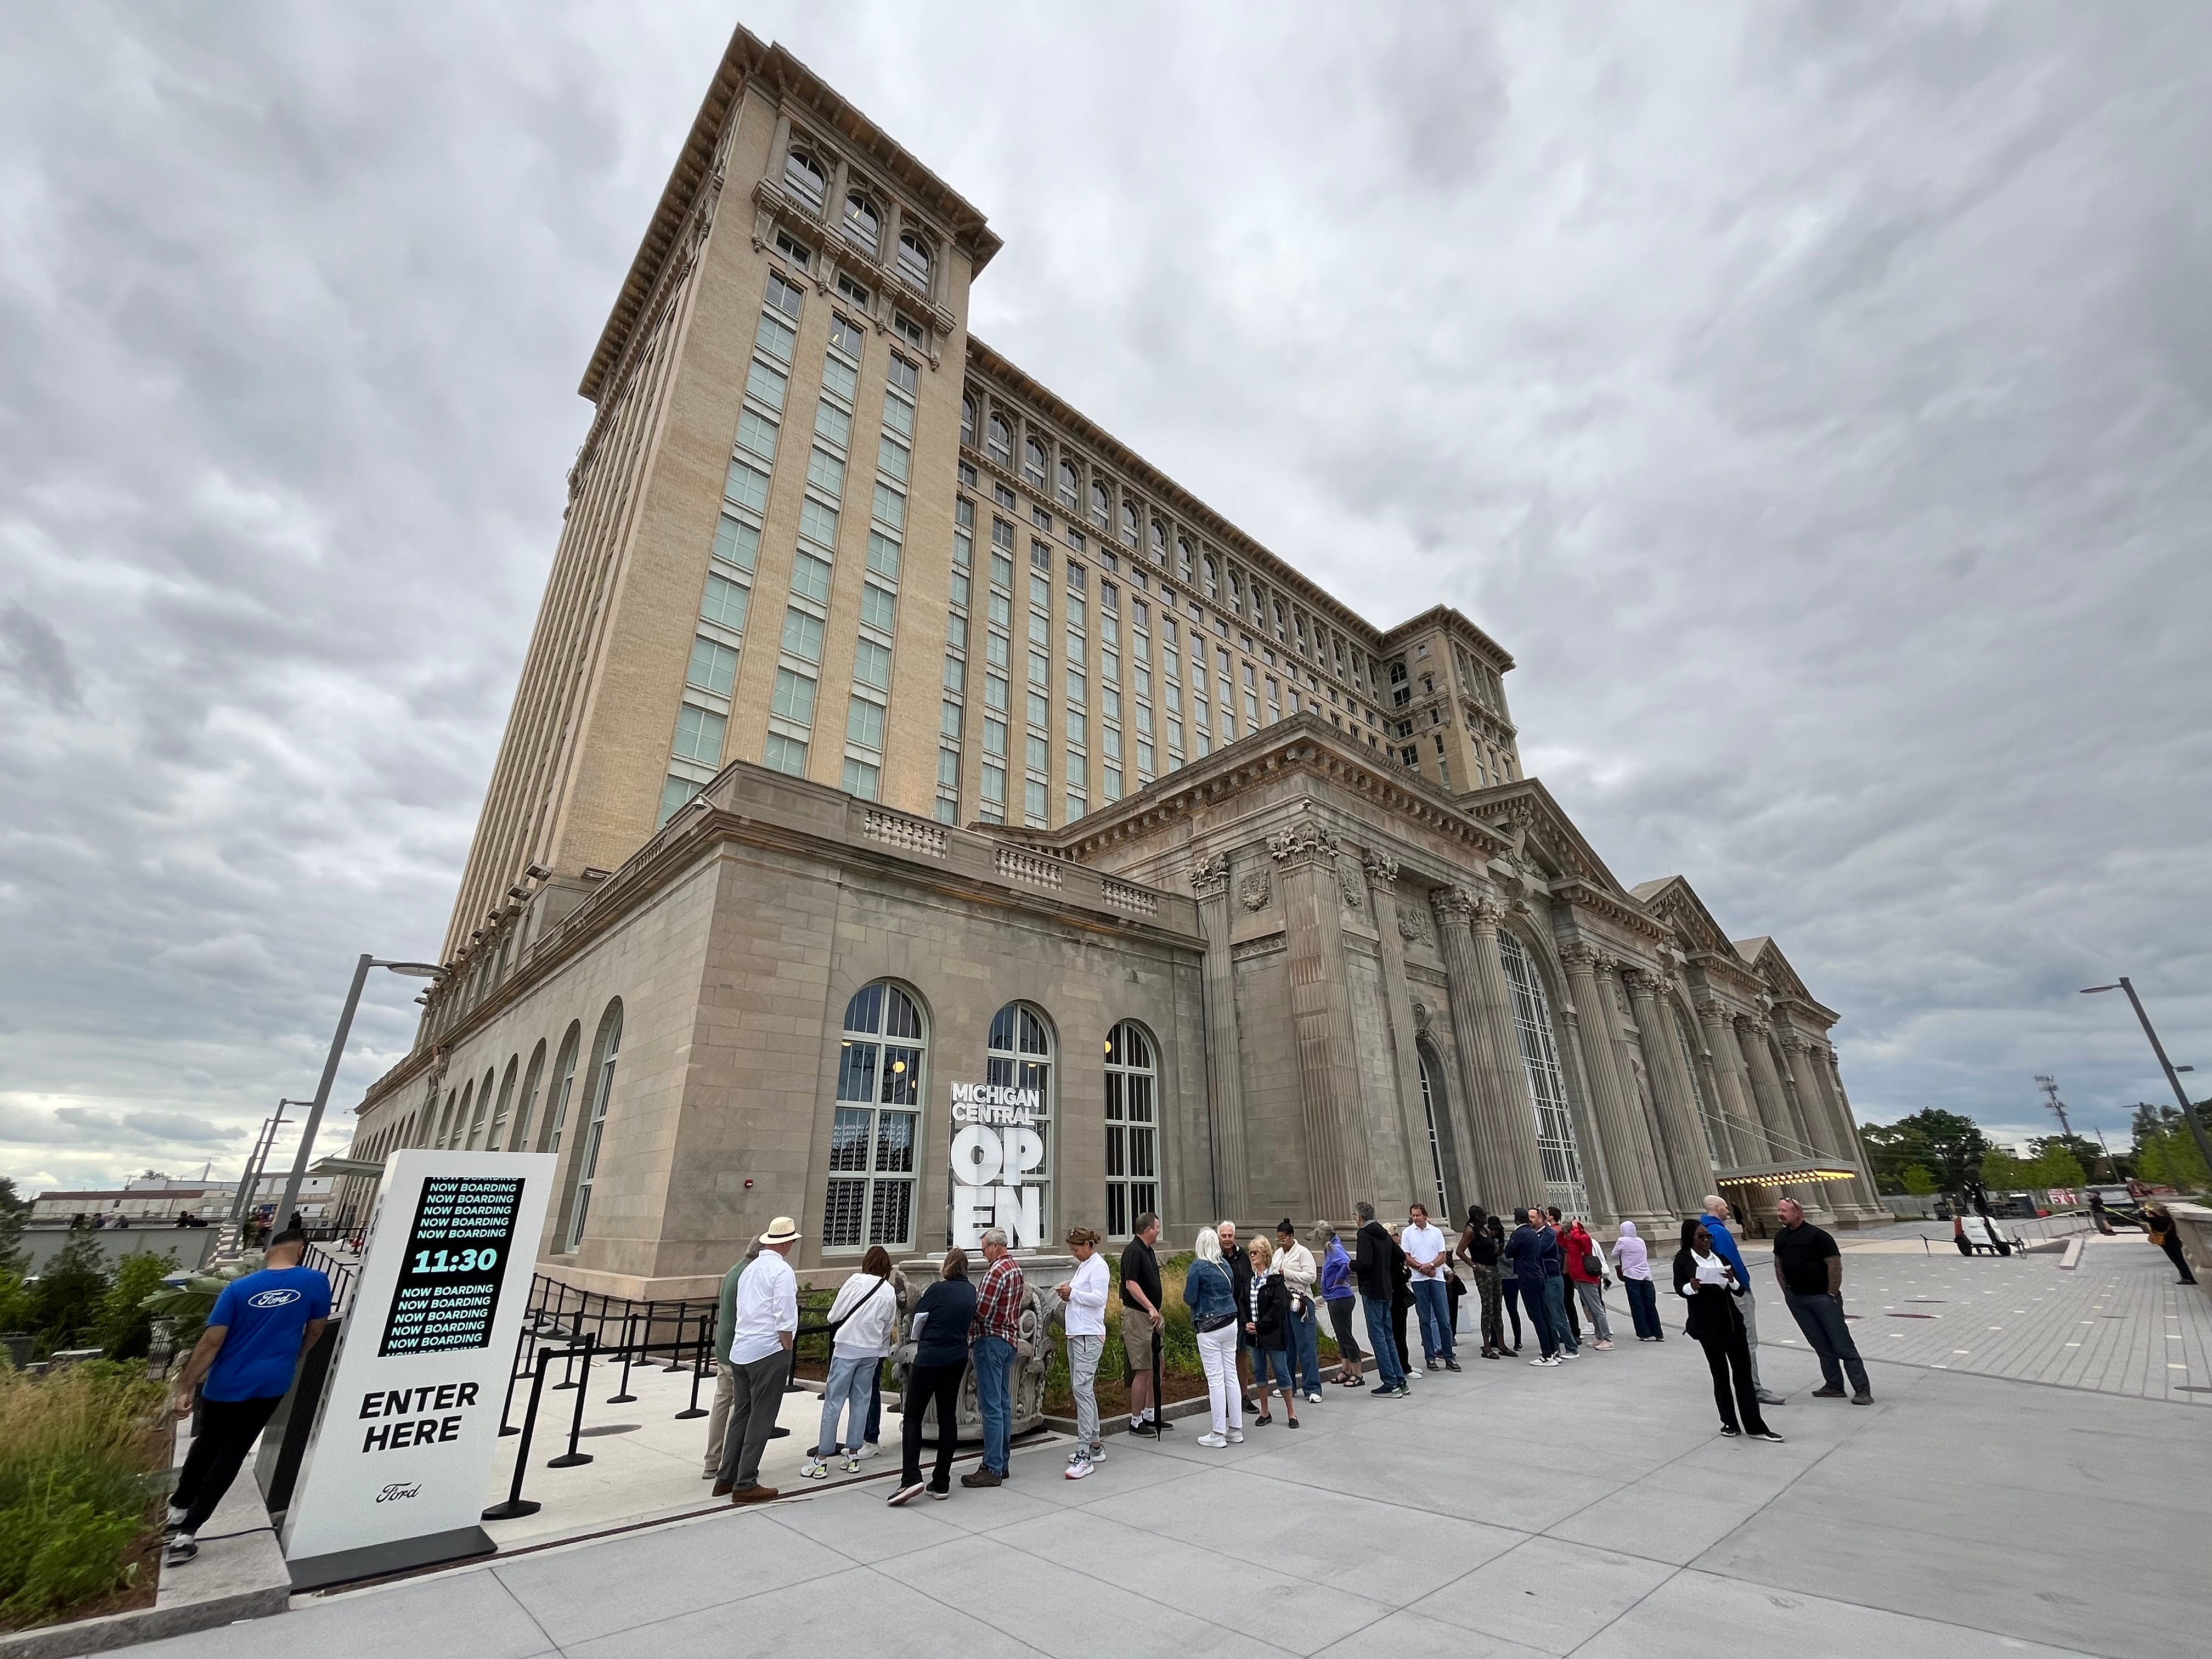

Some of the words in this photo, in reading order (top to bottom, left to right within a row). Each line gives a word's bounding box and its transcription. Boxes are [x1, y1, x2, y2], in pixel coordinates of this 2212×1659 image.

[952, 1083, 1039, 1107] MICHIGAN
[952, 1103, 1035, 1125] CENTRAL
[951, 1124, 1043, 1186] OP
[430, 1183, 458, 1192] NOW
[460, 1184, 516, 1192] BOARDING
[427, 1195, 455, 1203] NOW
[458, 1195, 514, 1203] BOARDING
[424, 1206, 453, 1215] NOW
[454, 1206, 511, 1215] BOARDING
[952, 1186, 1040, 1249] EN
[420, 1218, 450, 1227] NOW
[452, 1217, 509, 1226] BOARDING
[417, 1230, 447, 1239] NOW
[448, 1229, 506, 1238] BOARDING
[412, 1248, 497, 1273] 11:30
[401, 1288, 432, 1297] NOW
[434, 1284, 494, 1296] BOARDING
[258, 1291, 290, 1306] Ford
[398, 1300, 428, 1310] NOW
[431, 1296, 490, 1308] BOARDING
[394, 1312, 425, 1323] NOW
[427, 1308, 488, 1321] BOARDING
[391, 1325, 422, 1336] NOW
[424, 1321, 485, 1334] BOARDING
[387, 1338, 419, 1349] NOW
[421, 1333, 482, 1346] BOARDING
[358, 1382, 479, 1419] ENTER
[362, 1415, 462, 1453] HERE
[376, 1482, 422, 1503] Ford
